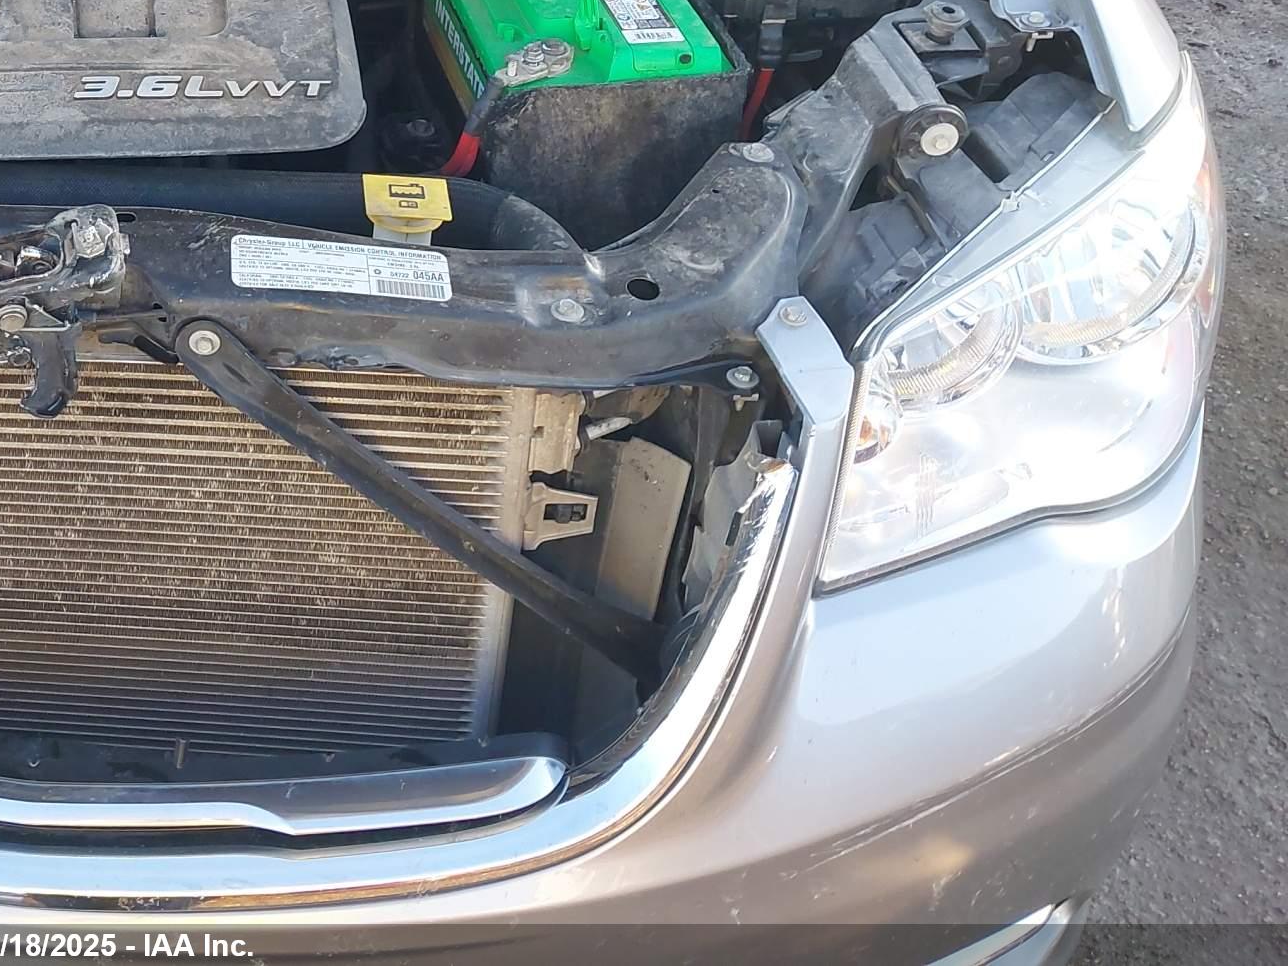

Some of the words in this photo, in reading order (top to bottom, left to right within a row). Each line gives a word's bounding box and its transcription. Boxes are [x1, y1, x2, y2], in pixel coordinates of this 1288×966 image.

[307, 242, 332, 250] VEHICLE
[335, 245, 365, 253] EMISSION
[367, 248, 396, 256] CONTROL
[398, 251, 442, 260] INFORMATION
[413, 270, 445, 282] 045AA
